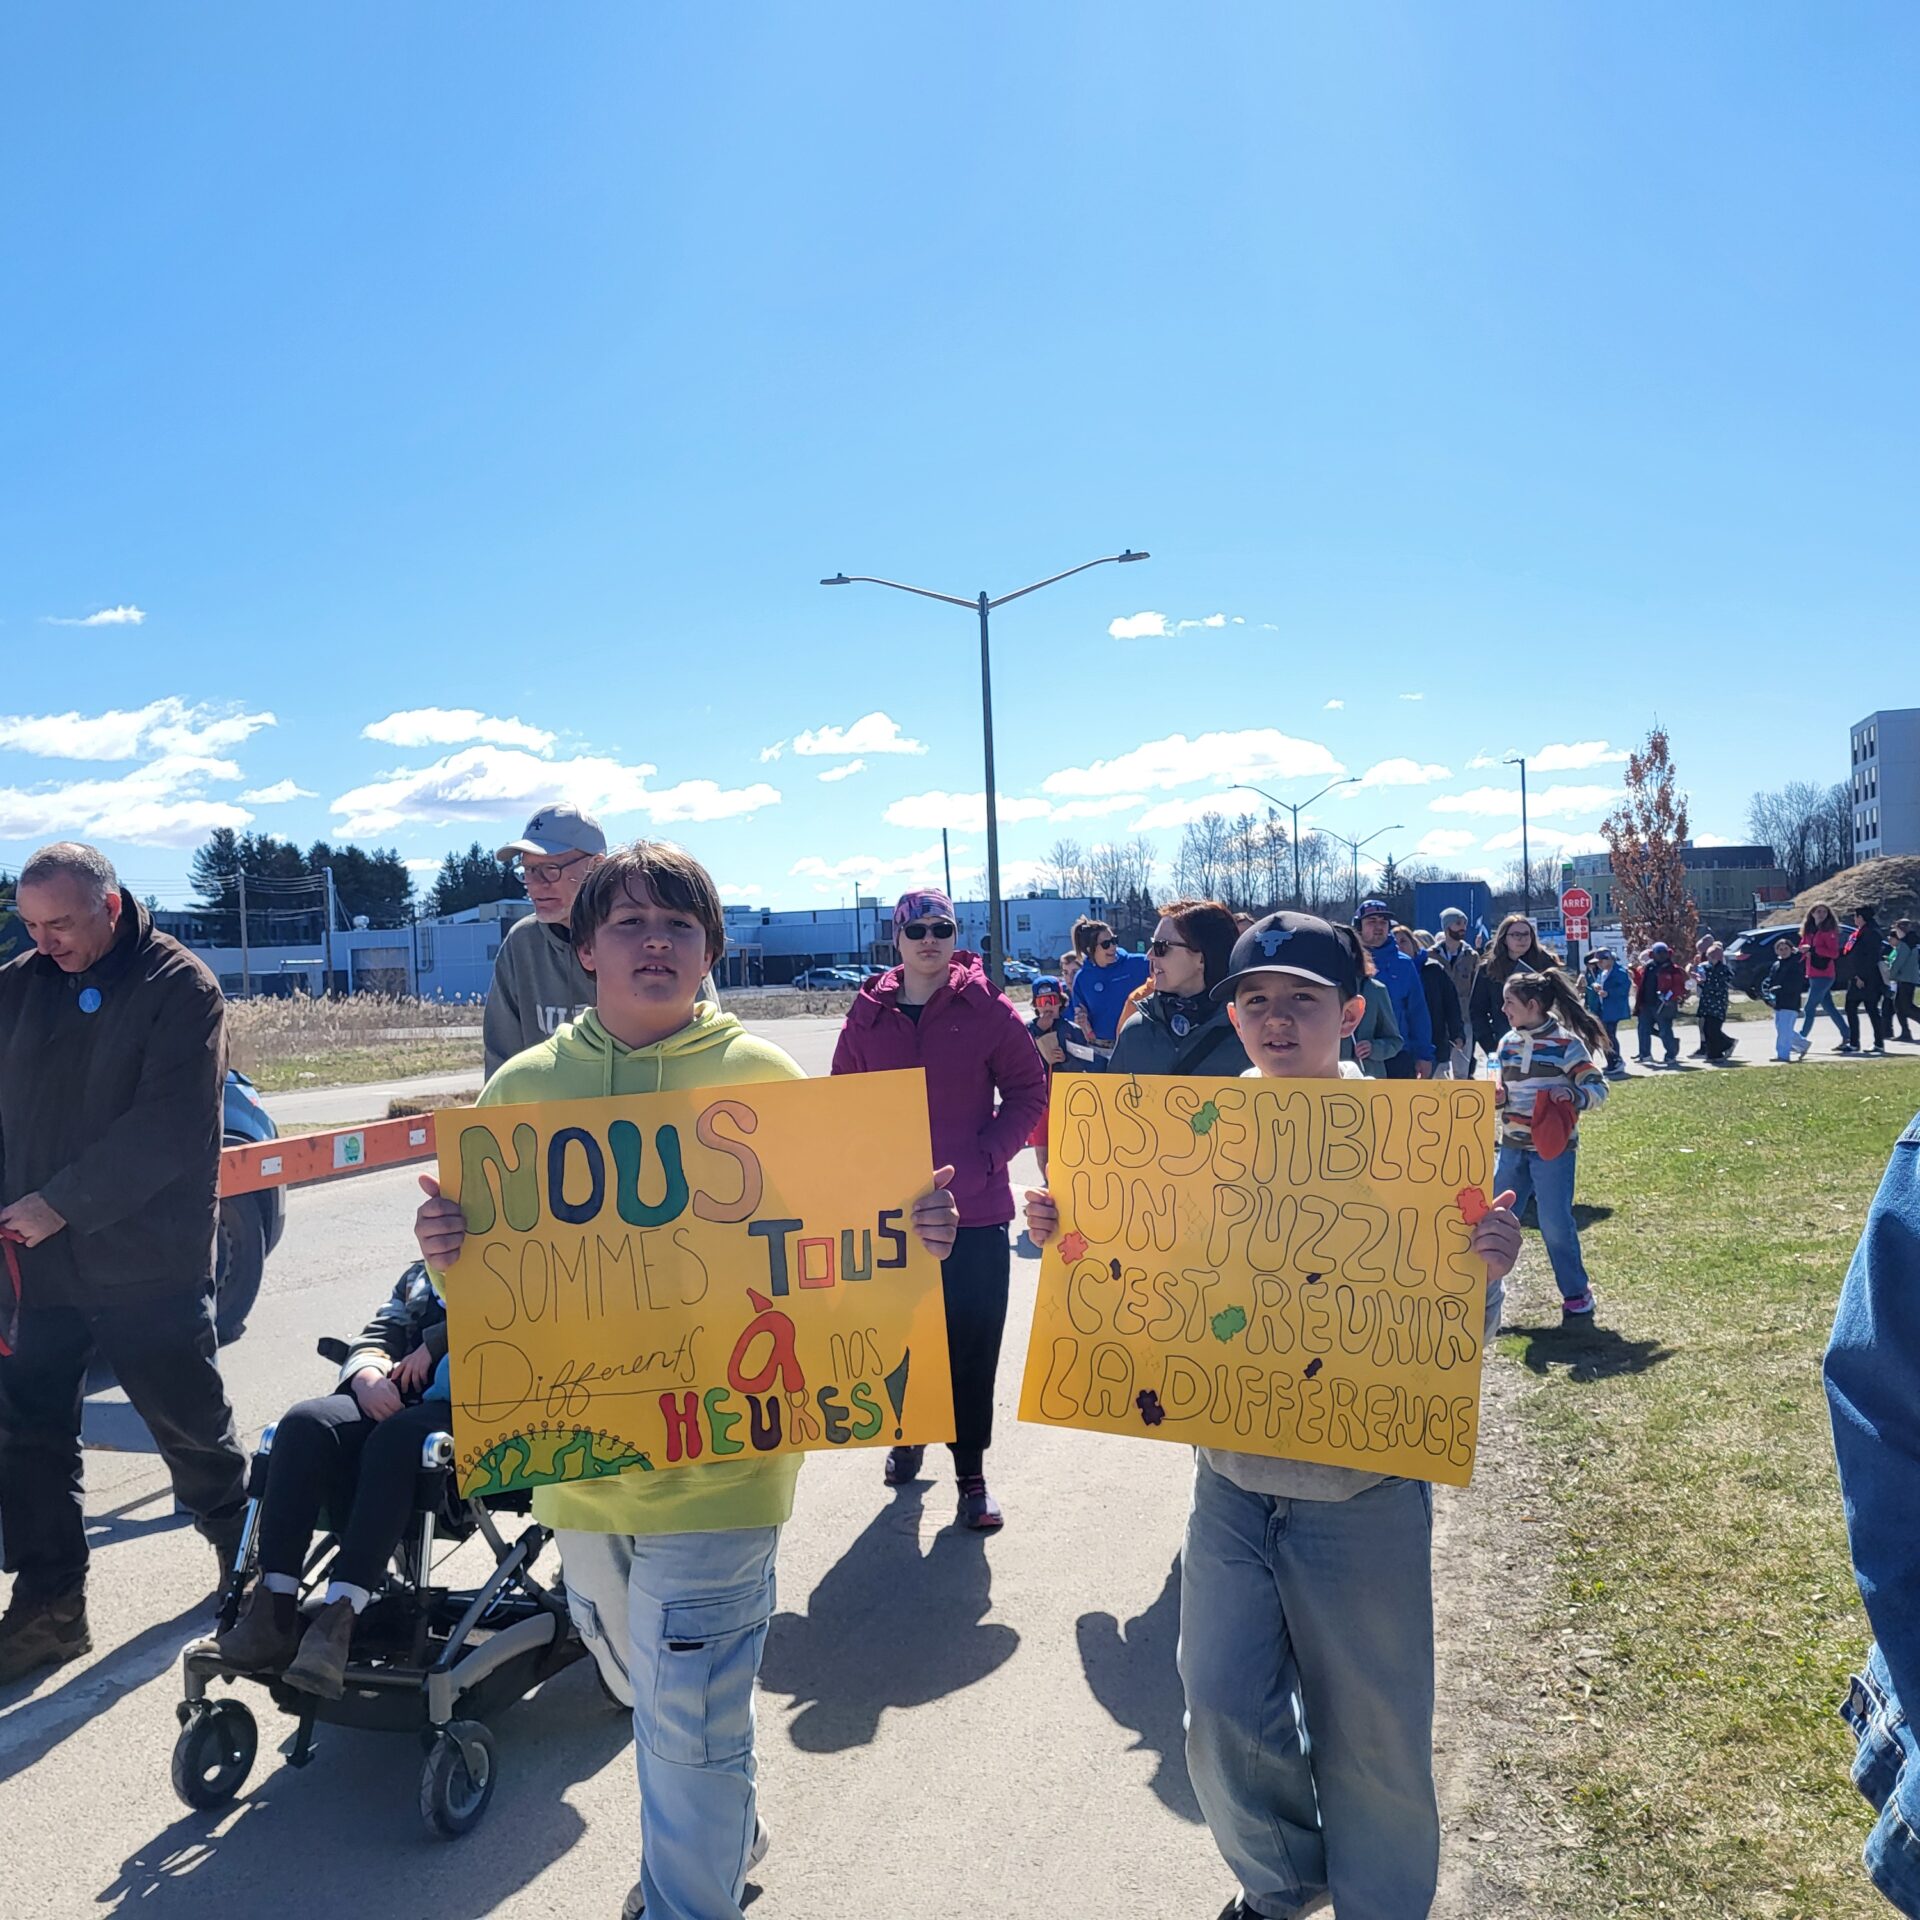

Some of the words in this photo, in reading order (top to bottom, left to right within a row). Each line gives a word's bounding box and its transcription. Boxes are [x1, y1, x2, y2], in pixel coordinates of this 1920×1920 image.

[1563, 897, 1590, 908] ARRÊT
[458, 1100, 763, 1235] NOUS
[1059, 1079, 1487, 1187] ASSEMBLER
[482, 1227, 709, 1331] SOMMES
[747, 1208, 908, 1297] TOUS
[1072, 1170, 1177, 1252] UN
[1206, 1183, 1476, 1295] PUZZLE
[1067, 1257, 1221, 1344] C'EST
[658, 1345, 911, 1462] HEURES!
[1039, 1337, 1135, 1420] LA
[1158, 1354, 1474, 1467] DIFFÉRENCE
